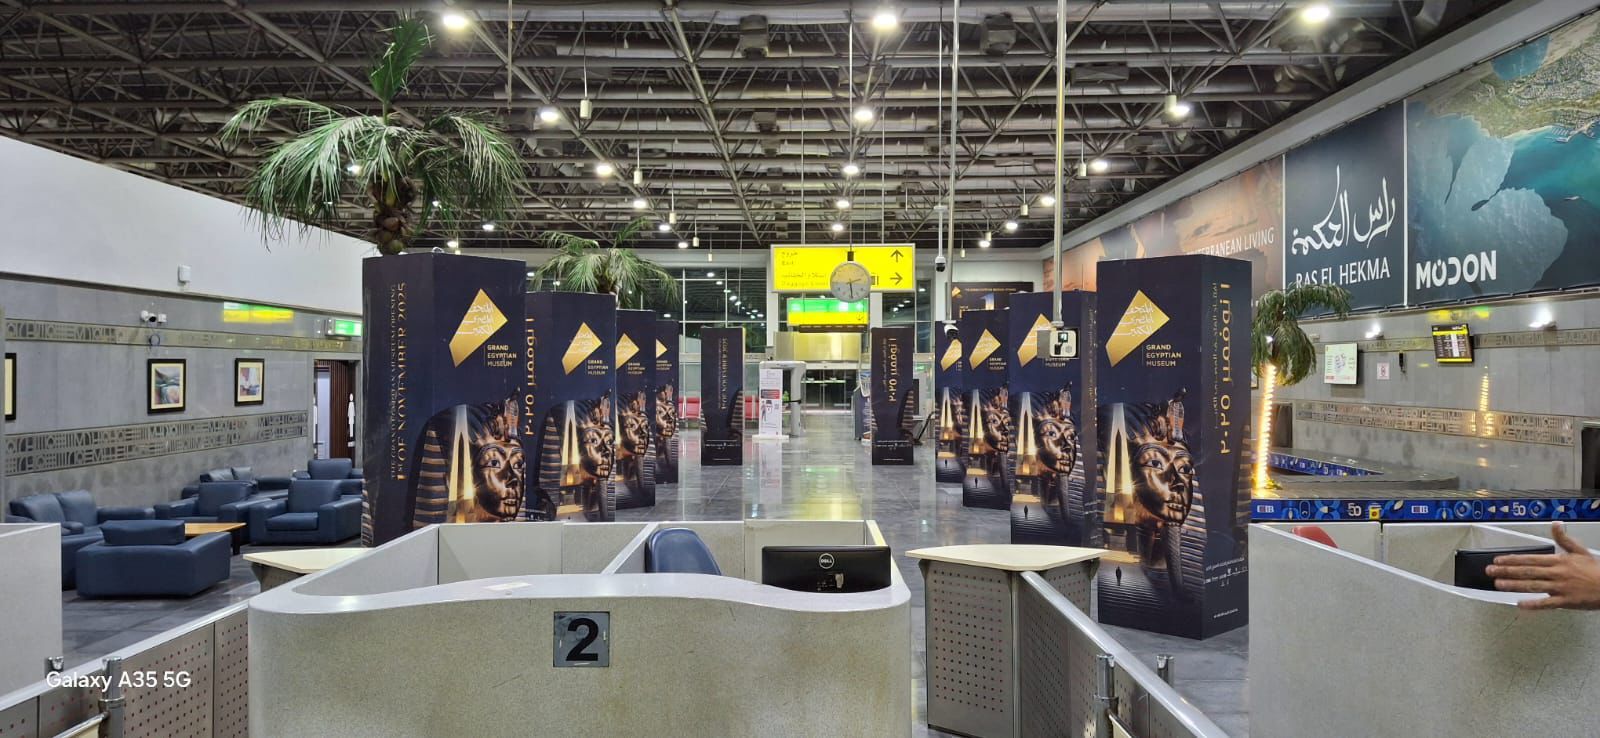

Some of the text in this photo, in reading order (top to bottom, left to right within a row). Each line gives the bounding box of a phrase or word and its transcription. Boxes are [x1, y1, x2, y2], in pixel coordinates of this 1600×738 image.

[1244, 227, 1274, 250] LIVING
[1296, 270, 1318, 288] RAS
[1339, 257, 1391, 285] HEKMA
[1415, 250, 1497, 290] MODON
[397, 282, 406, 320] 2025
[1219, 299, 1233, 386] نوفمبر
[397, 327, 406, 430] NOVEMBER
[1220, 394, 1231, 454] ٢٠٢٥
[397, 436, 406, 461] OF
[566, 618, 598, 662] 2
